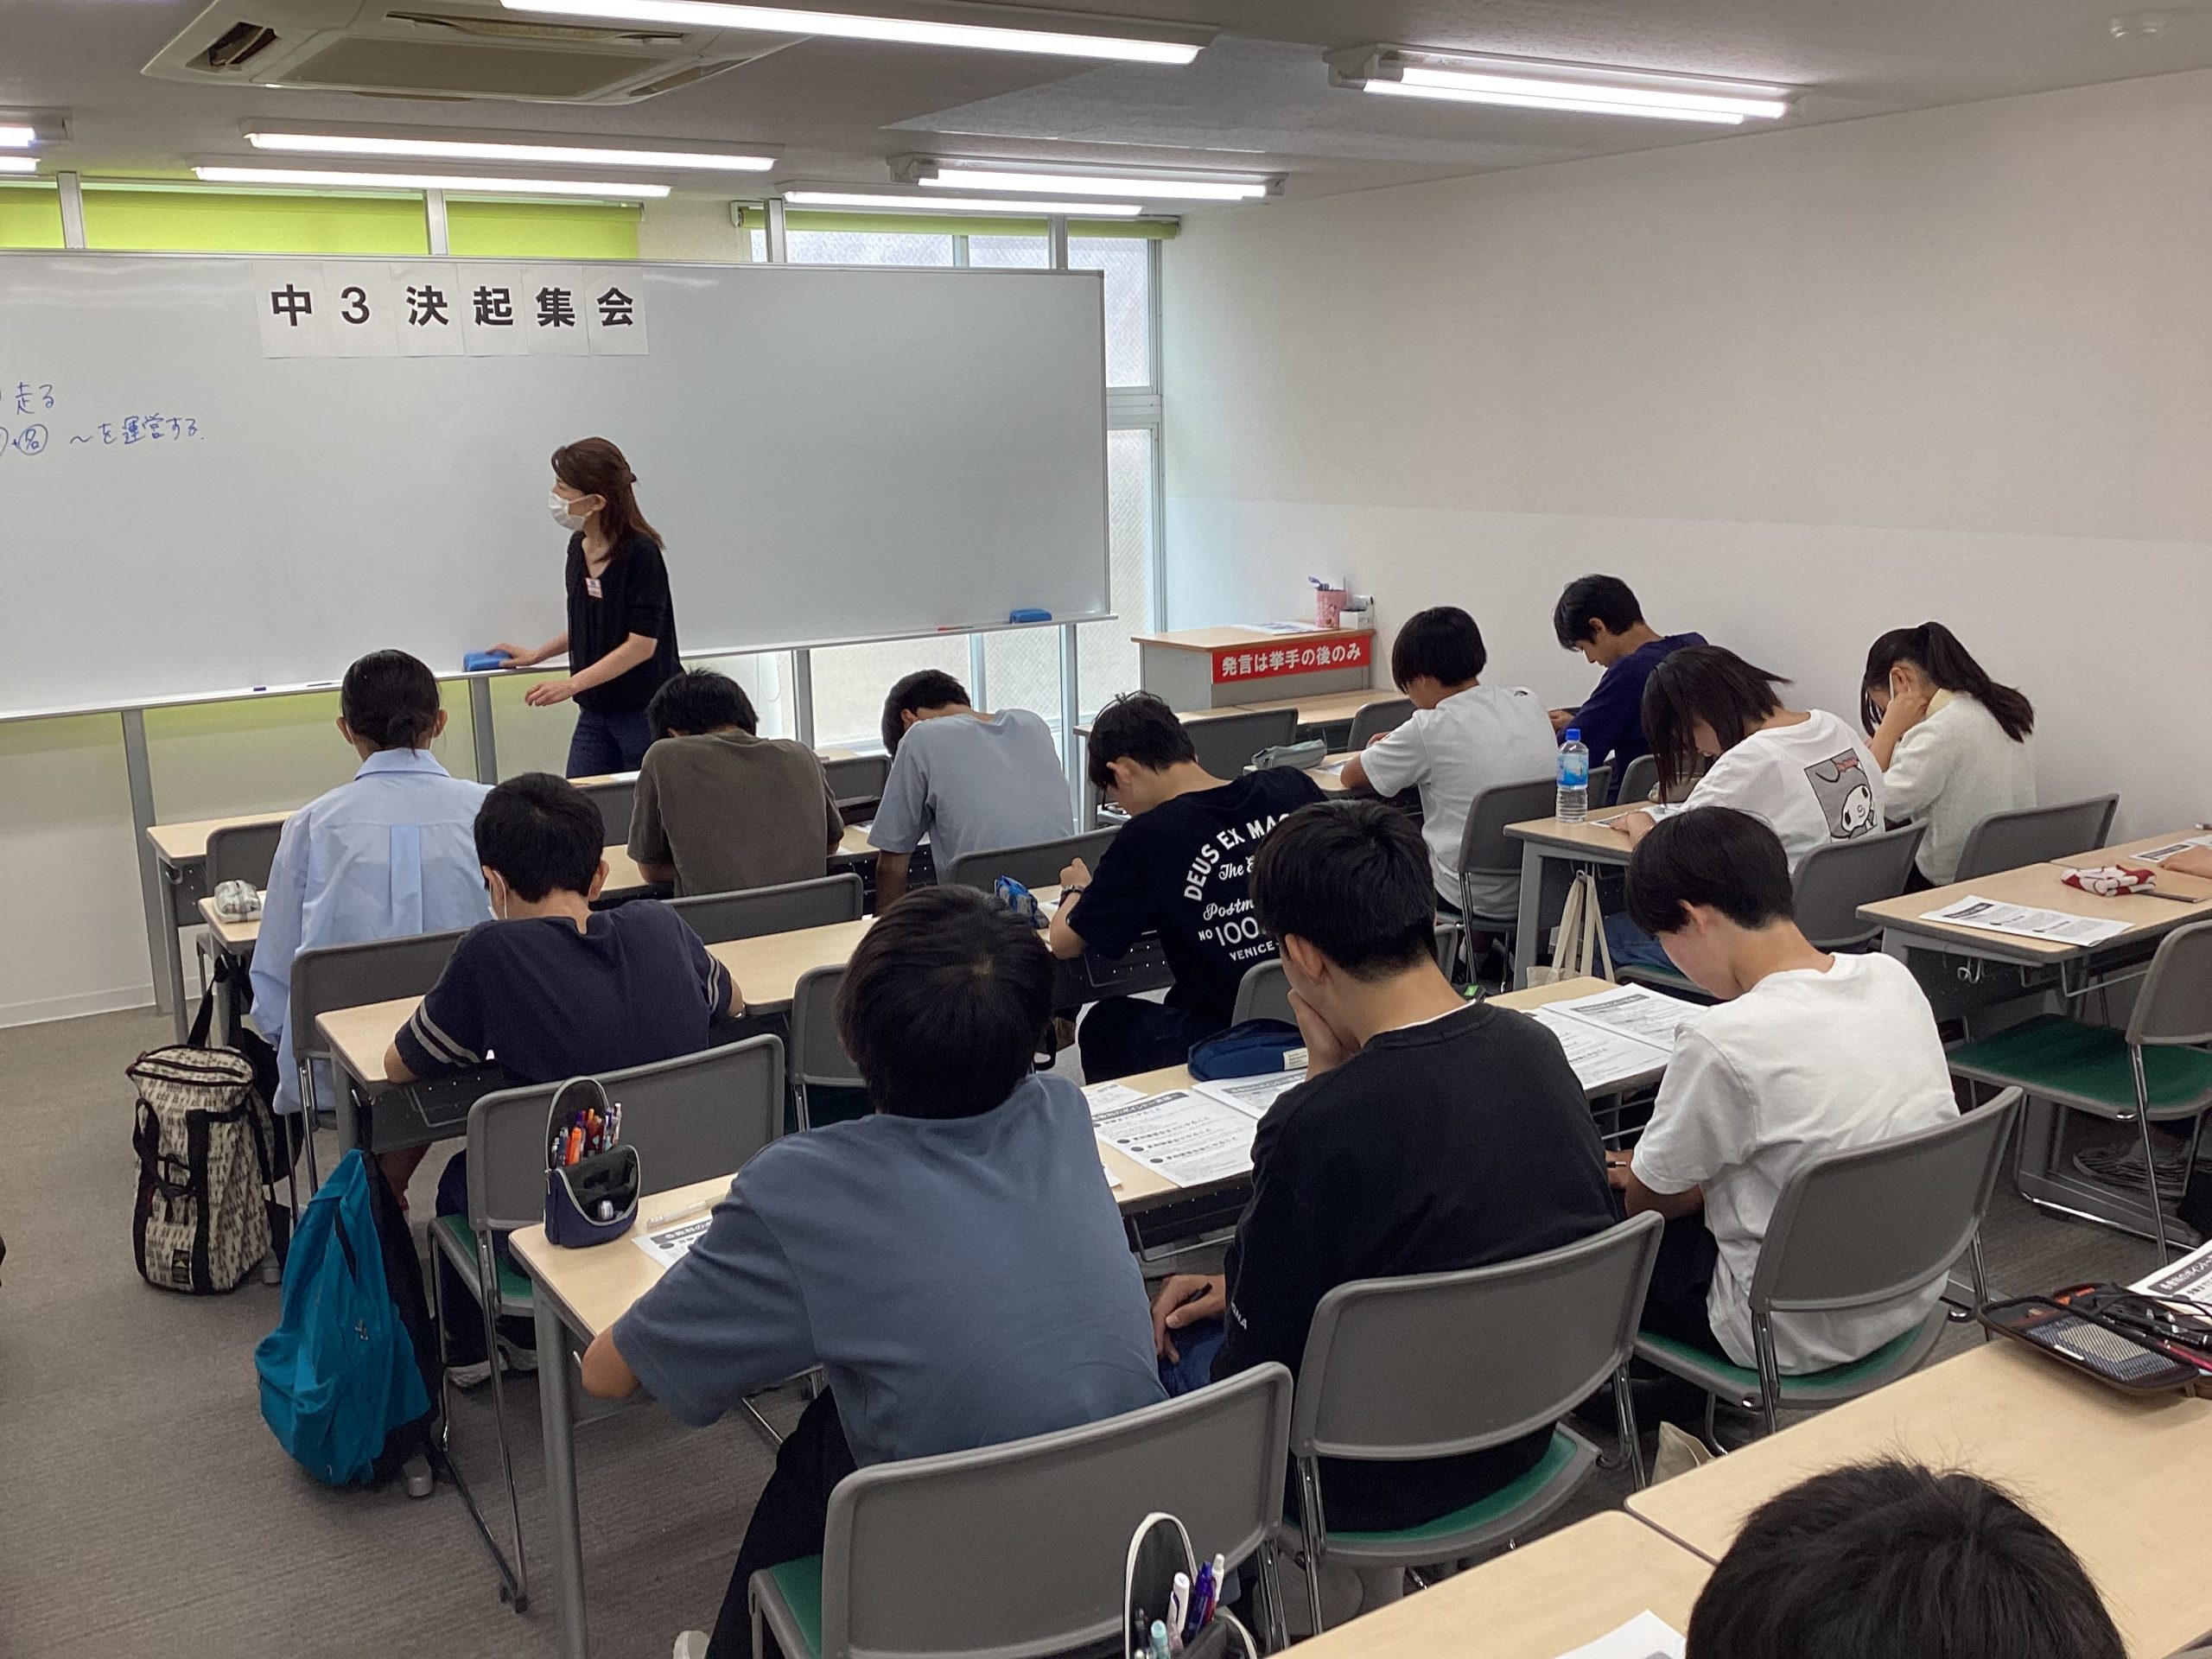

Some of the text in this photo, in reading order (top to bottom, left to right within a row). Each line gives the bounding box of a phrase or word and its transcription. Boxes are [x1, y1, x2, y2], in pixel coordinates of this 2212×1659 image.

[15, 382, 54, 415] 走る
[1222, 642, 1362, 677] 発言は挙手の後のみ
[1184, 813, 1290, 901] DEUS EX MA
[1218, 862, 1244, 880] The
